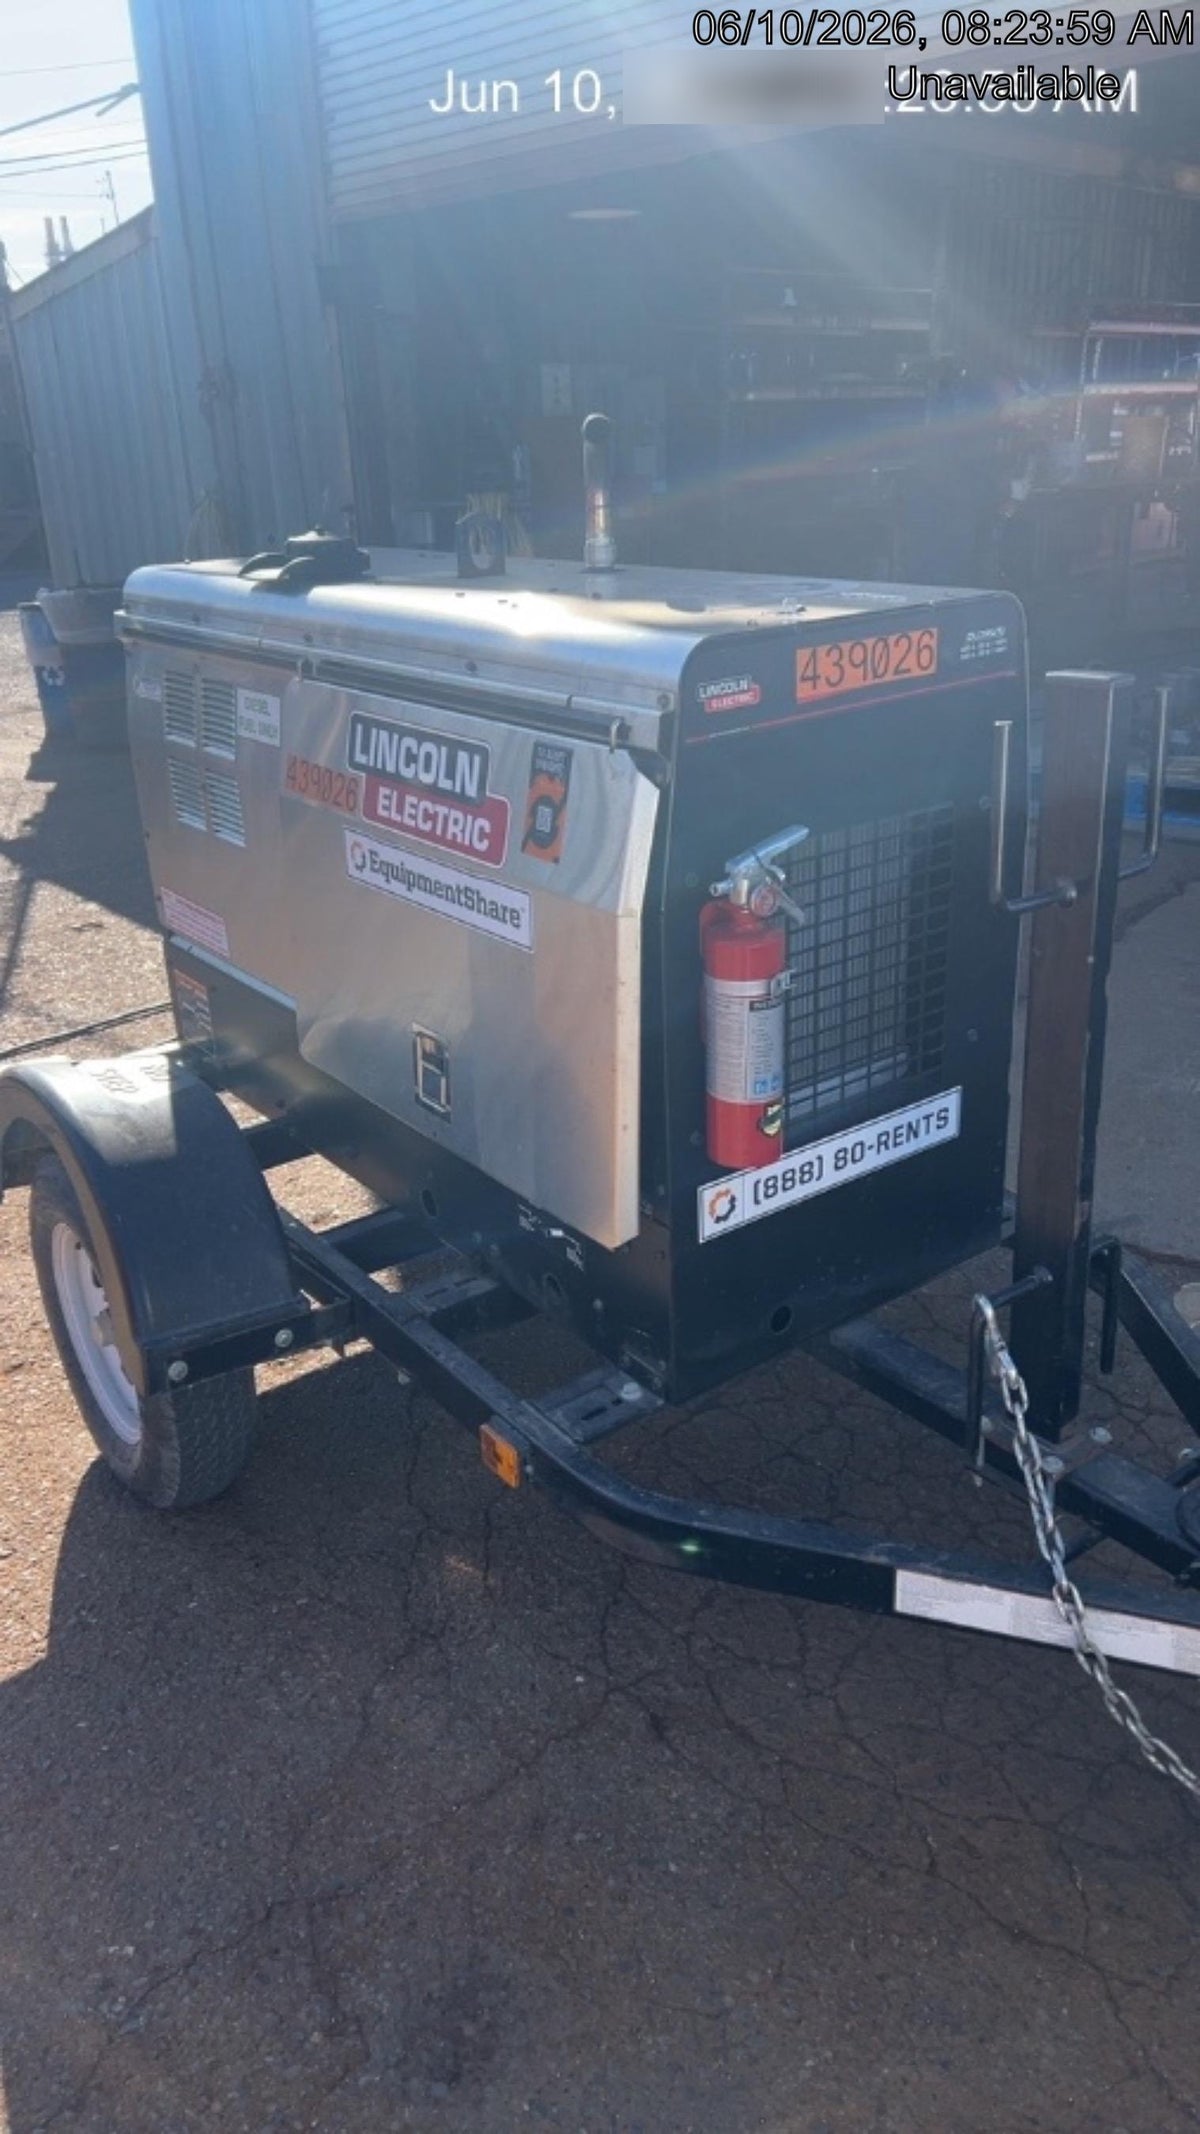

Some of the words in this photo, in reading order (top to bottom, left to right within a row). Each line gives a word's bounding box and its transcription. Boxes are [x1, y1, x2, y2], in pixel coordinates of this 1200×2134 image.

[800, 630, 937, 691] 439026
[286, 754, 361, 814] 439026
[354, 721, 481, 799] LINCOLN
[376, 785, 492, 853] ELECTRIC
[369, 849, 522, 931] EquipmentShare
[753, 1154, 824, 1206] (888)
[833, 1106, 951, 1172] 80-RENTS
